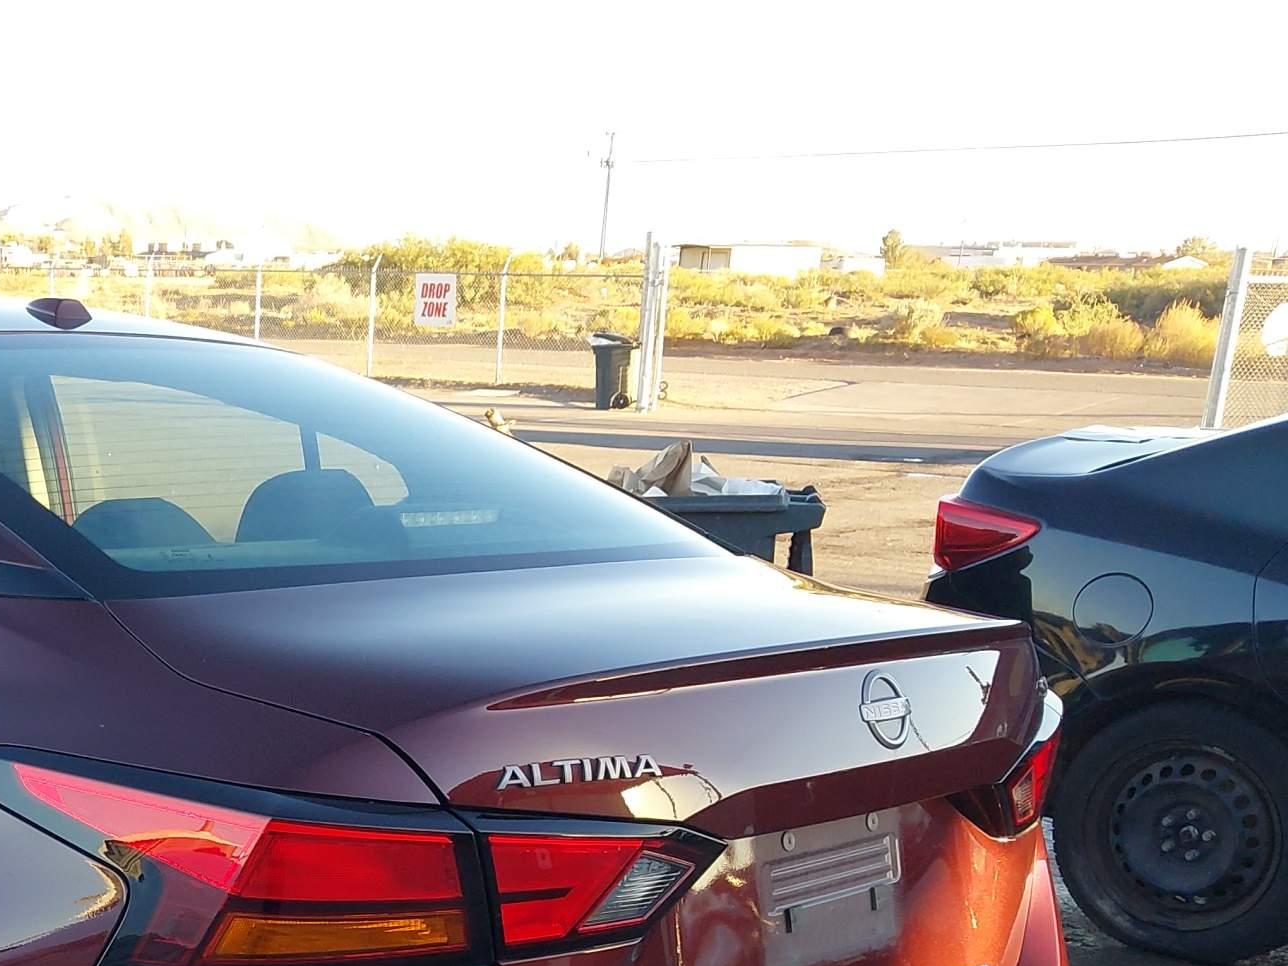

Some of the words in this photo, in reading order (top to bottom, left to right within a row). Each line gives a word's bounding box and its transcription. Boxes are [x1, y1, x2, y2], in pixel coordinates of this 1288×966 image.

[421, 283, 450, 299] DROP
[421, 302, 448, 317] ZONE
[497, 754, 662, 791] ALTIMA
